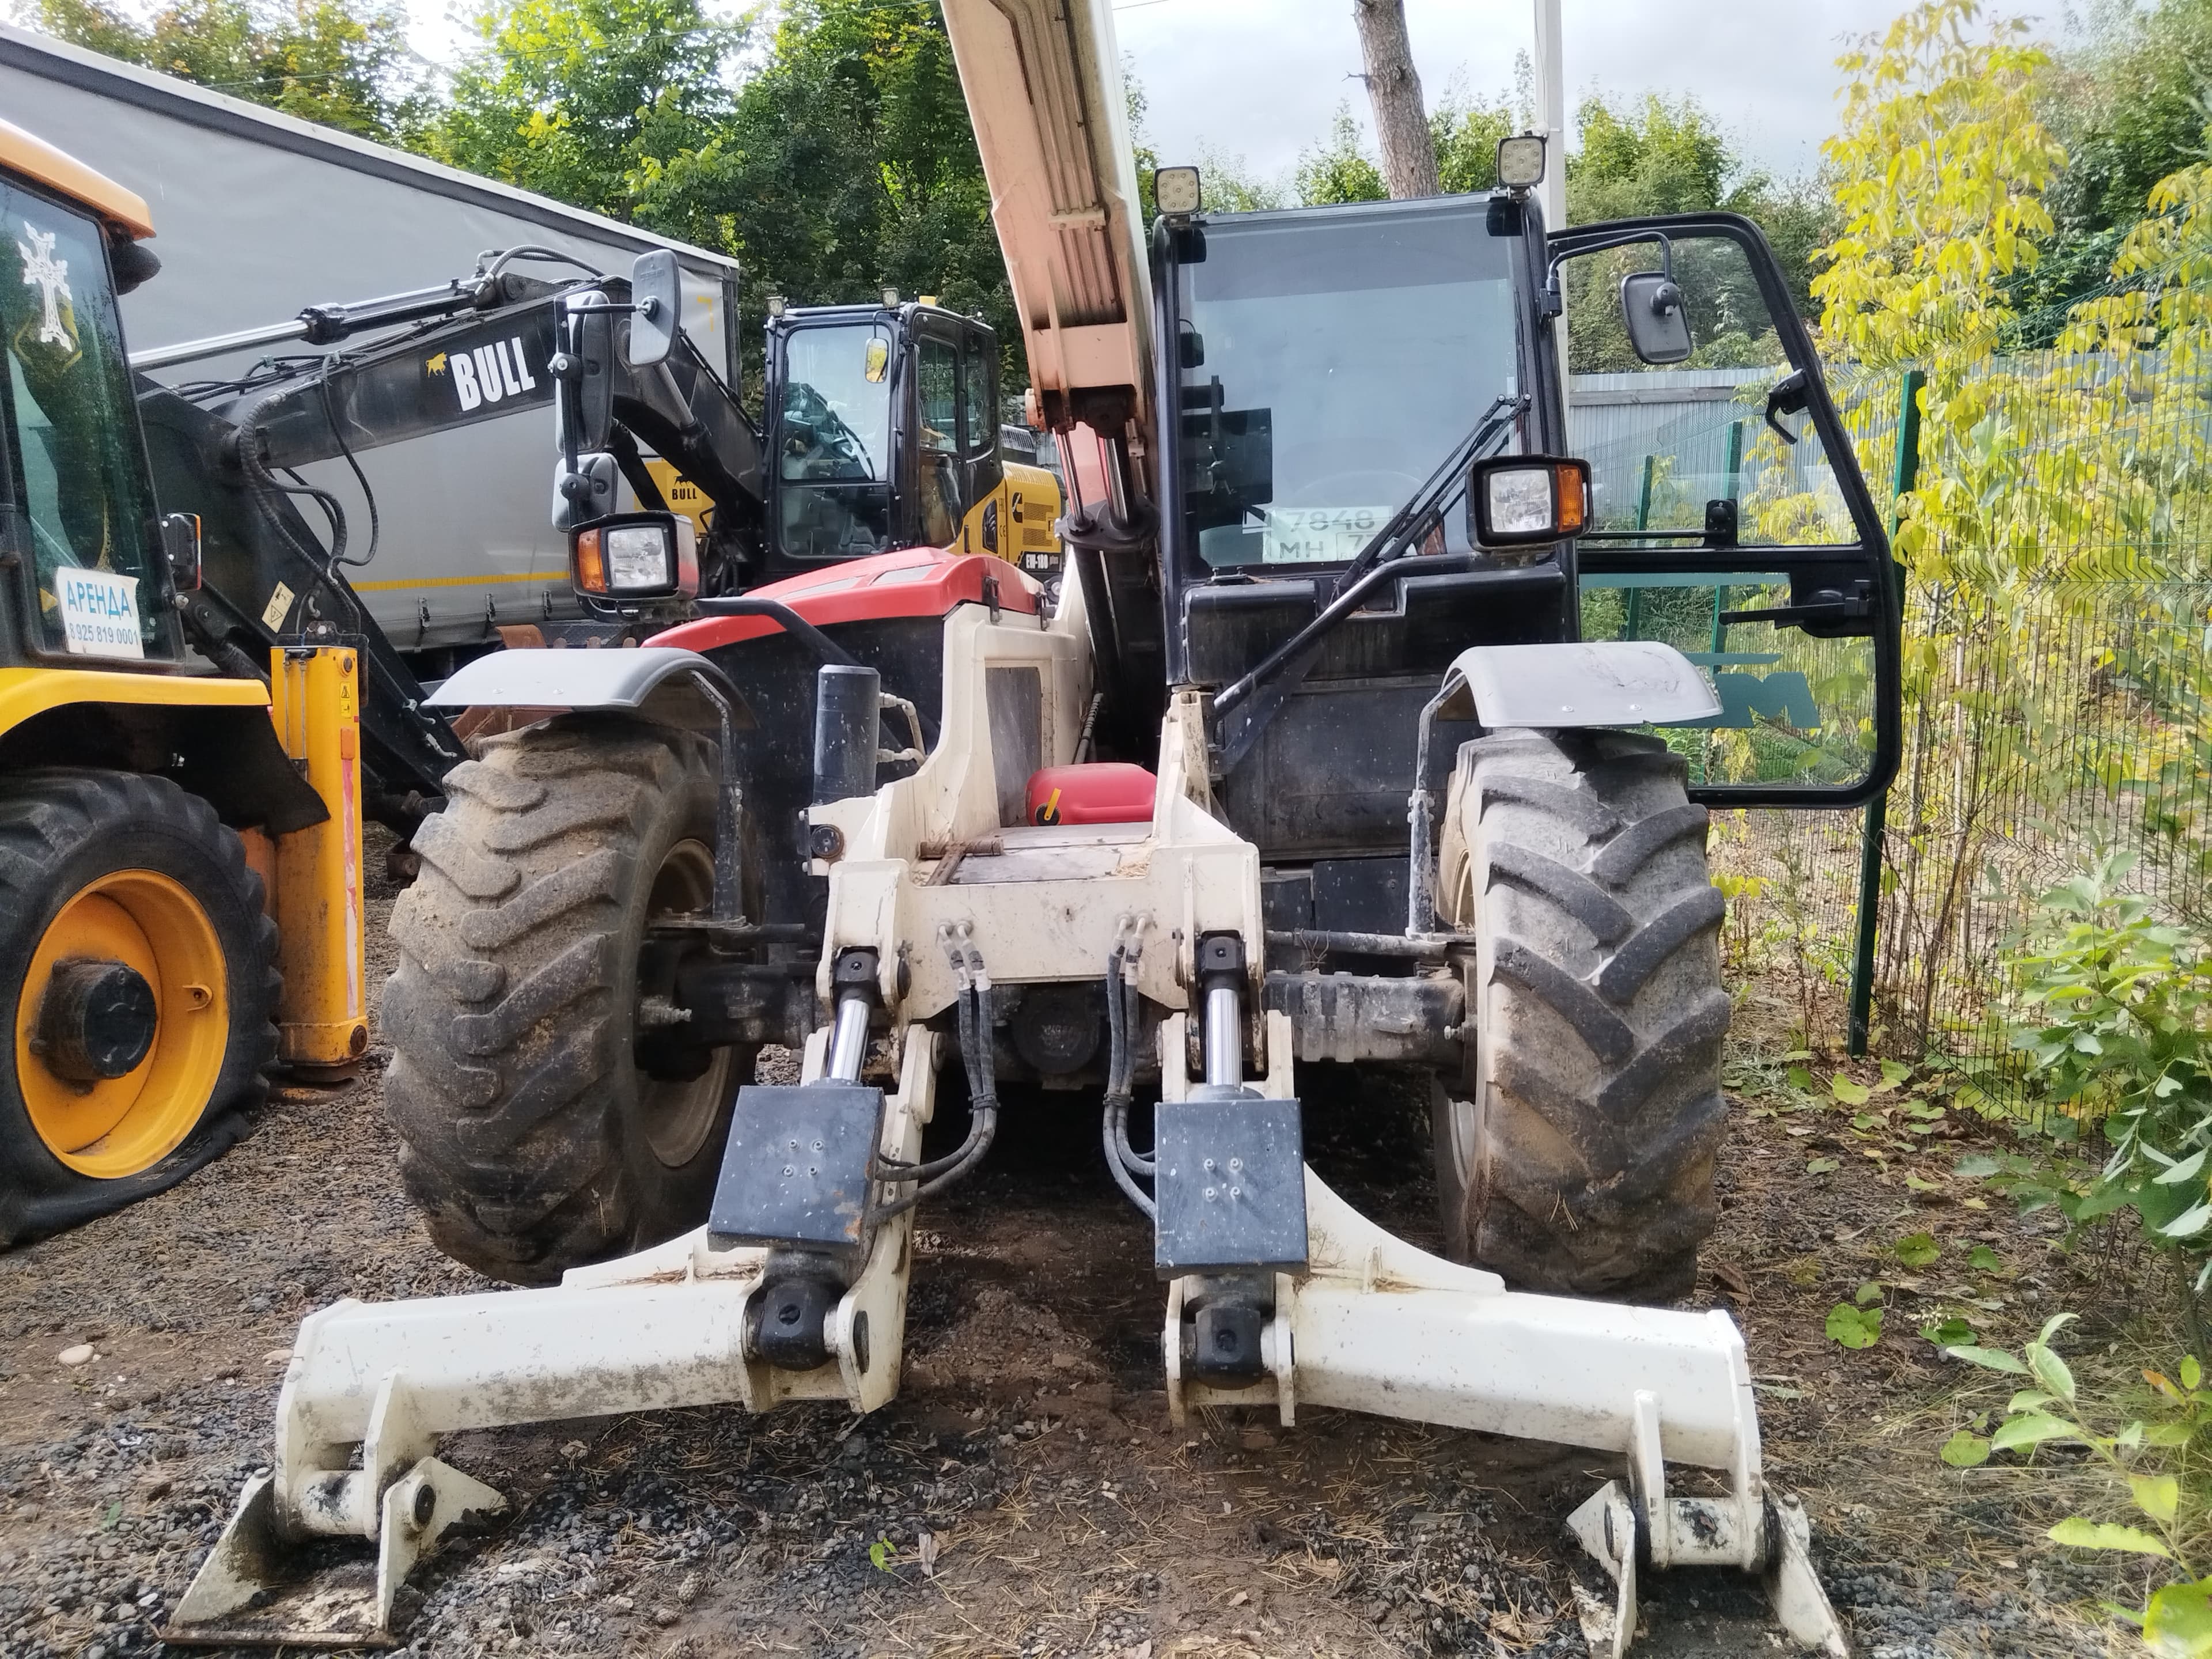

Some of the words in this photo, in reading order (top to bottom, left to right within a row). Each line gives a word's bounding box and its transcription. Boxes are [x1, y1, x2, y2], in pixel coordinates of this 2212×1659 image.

[449, 336, 536, 411] BULL
[672, 488, 697, 500] BULL
[1286, 509, 1375, 532] 7848
[1348, 534, 1376, 551] 7
[67, 580, 132, 620] АРЕНДА
[69, 622, 75, 639] 8
[76, 624, 94, 642] 925
[97, 626, 114, 643] 819
[116, 627, 139, 646] 0001
